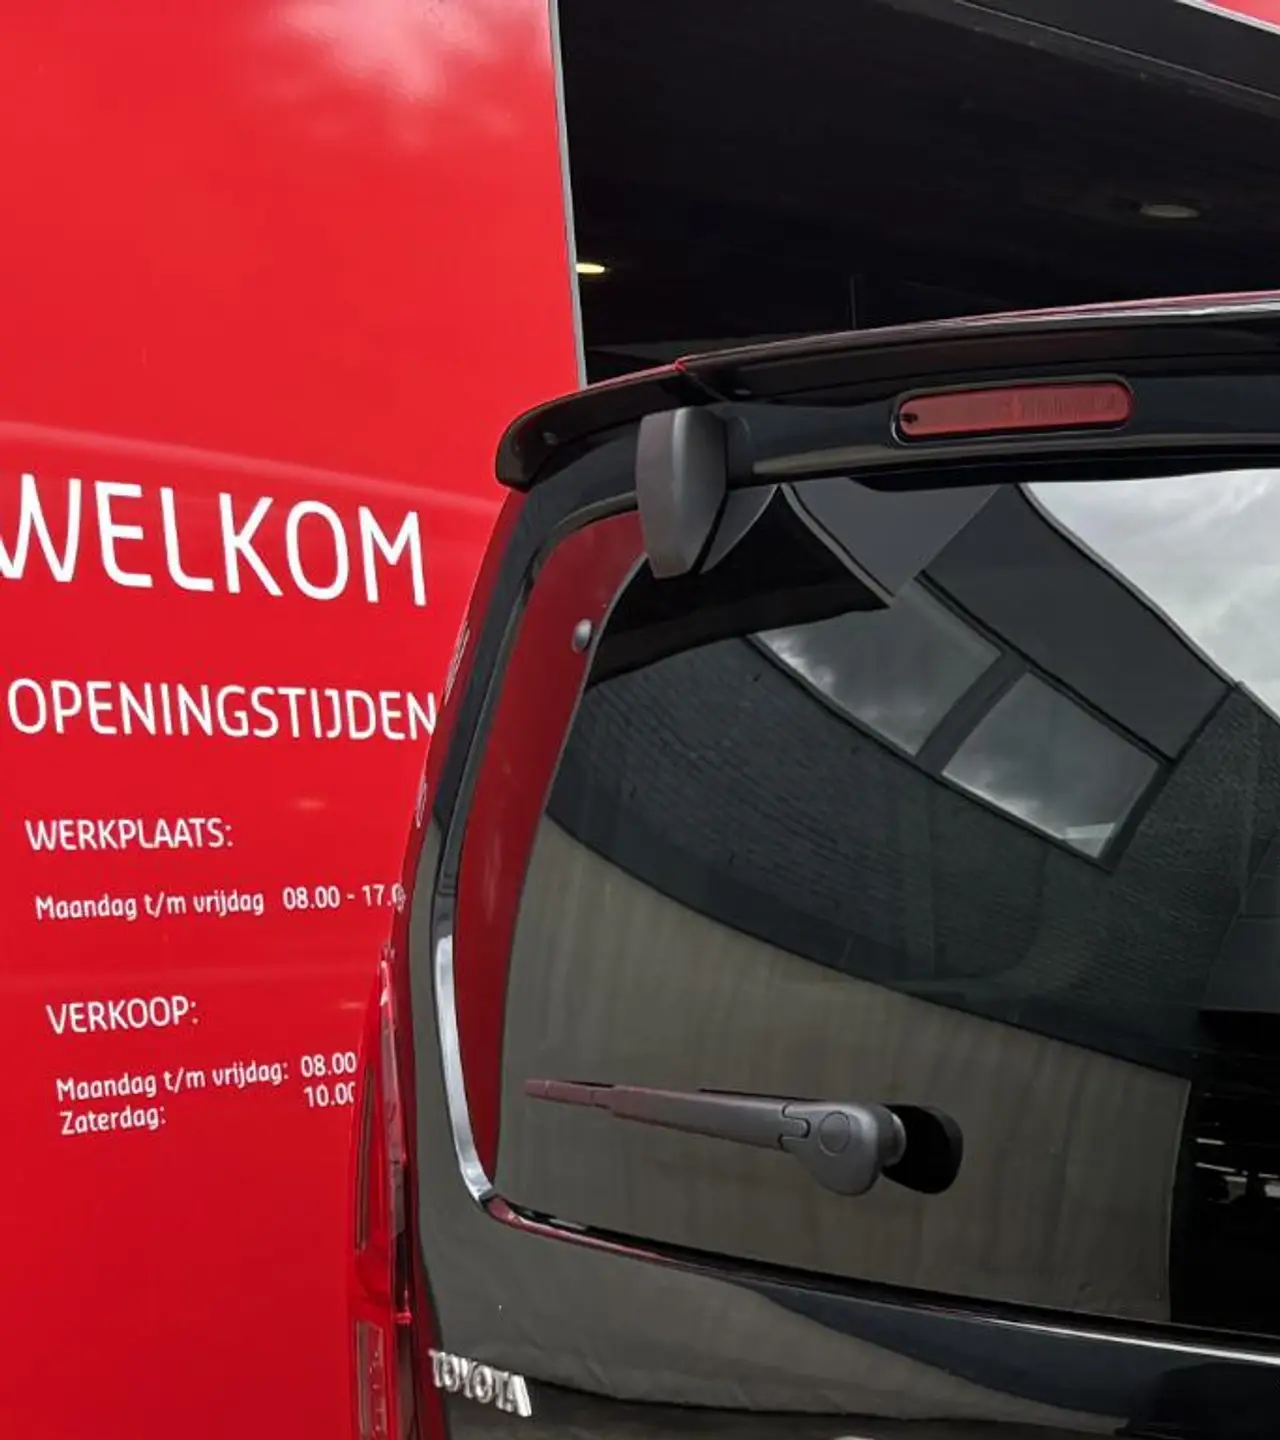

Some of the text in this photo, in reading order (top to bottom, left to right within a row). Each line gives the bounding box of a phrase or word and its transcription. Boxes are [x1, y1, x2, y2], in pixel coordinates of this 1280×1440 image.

[0, 473, 427, 607] WELKOM
[7, 677, 438, 741] OPENINGSTIJDEN
[24, 817, 234, 852] WERKPLAATS:
[35, 893, 137, 922] Maandag
[144, 891, 187, 919] t/m
[193, 888, 265, 918] vrijdag
[282, 885, 341, 911] 08.00
[45, 995, 199, 1035] VERKOOP:
[55, 1051, 357, 1103] Maandag t/m vrijdag: 08.00
[60, 1105, 167, 1136] Zaterdag:
[428, 1348, 532, 1418] TOYOTA
